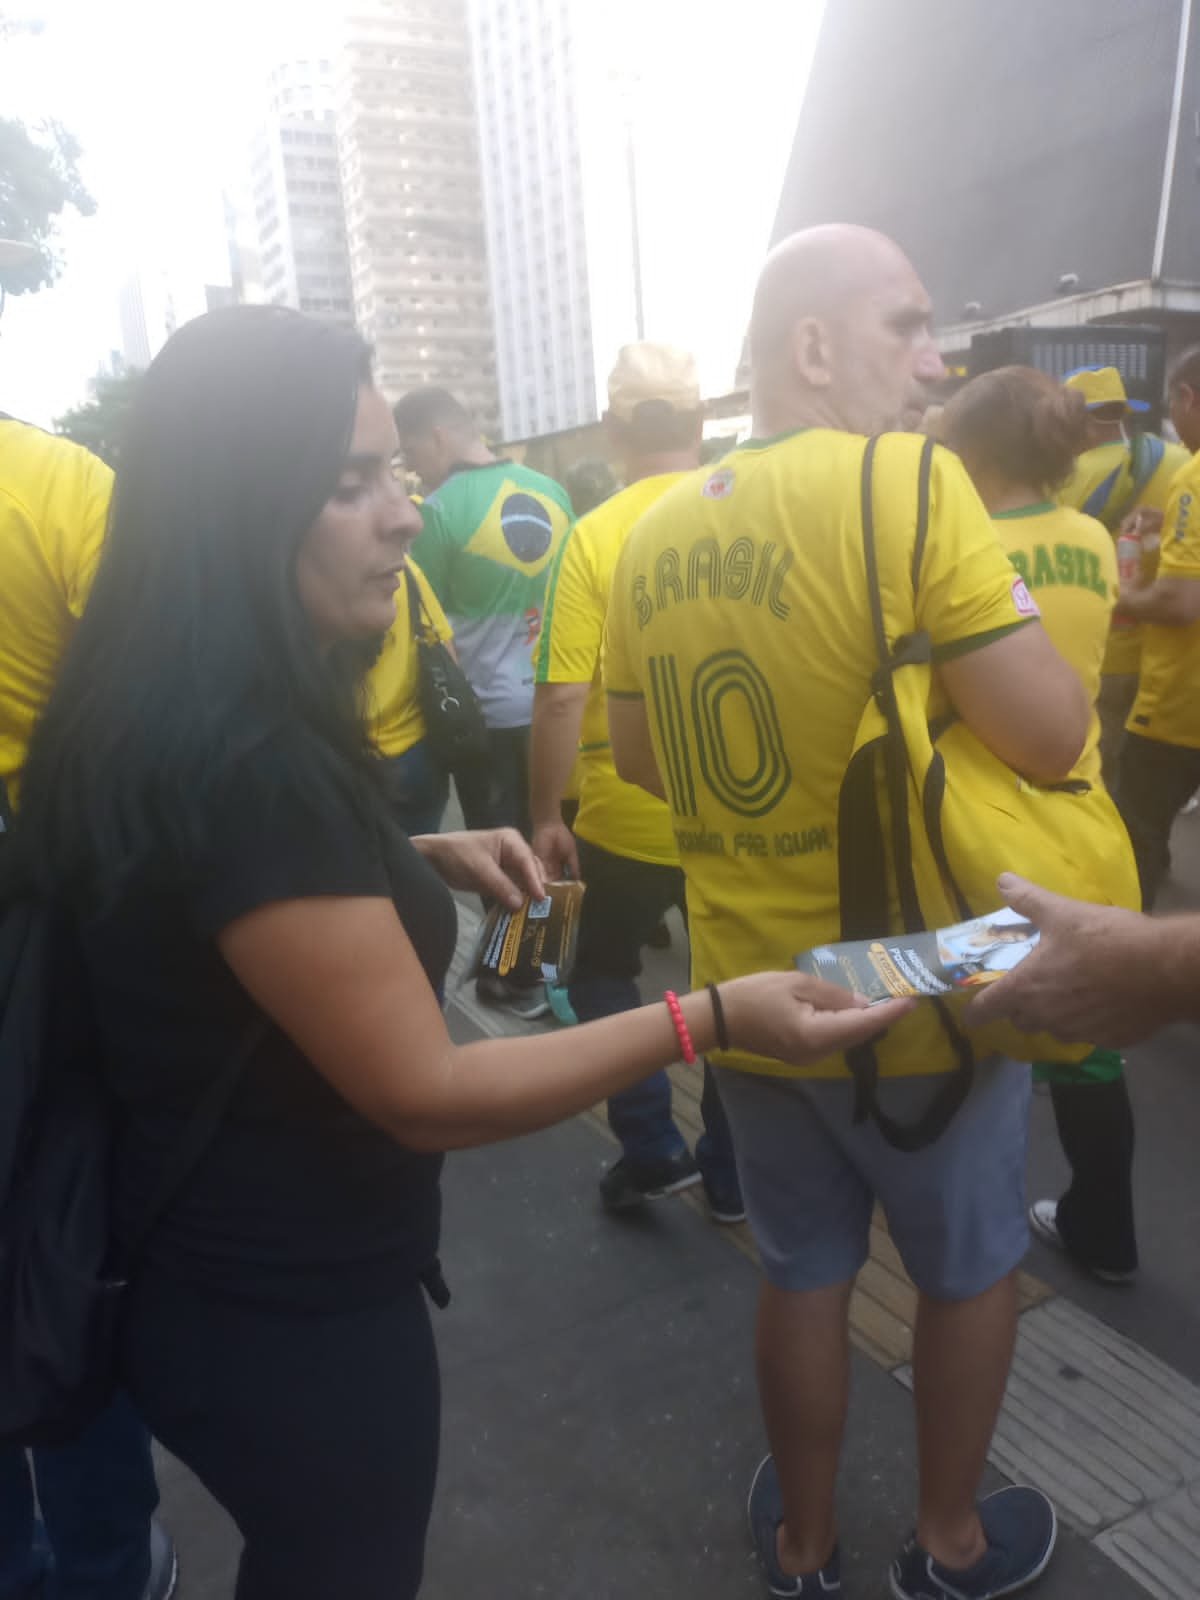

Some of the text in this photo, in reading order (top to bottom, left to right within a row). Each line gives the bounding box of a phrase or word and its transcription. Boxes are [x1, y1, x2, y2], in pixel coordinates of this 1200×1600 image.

[632, 536, 794, 632] BRASIL
[1007, 543, 1109, 602] RASIL
[648, 648, 793, 818] 10
